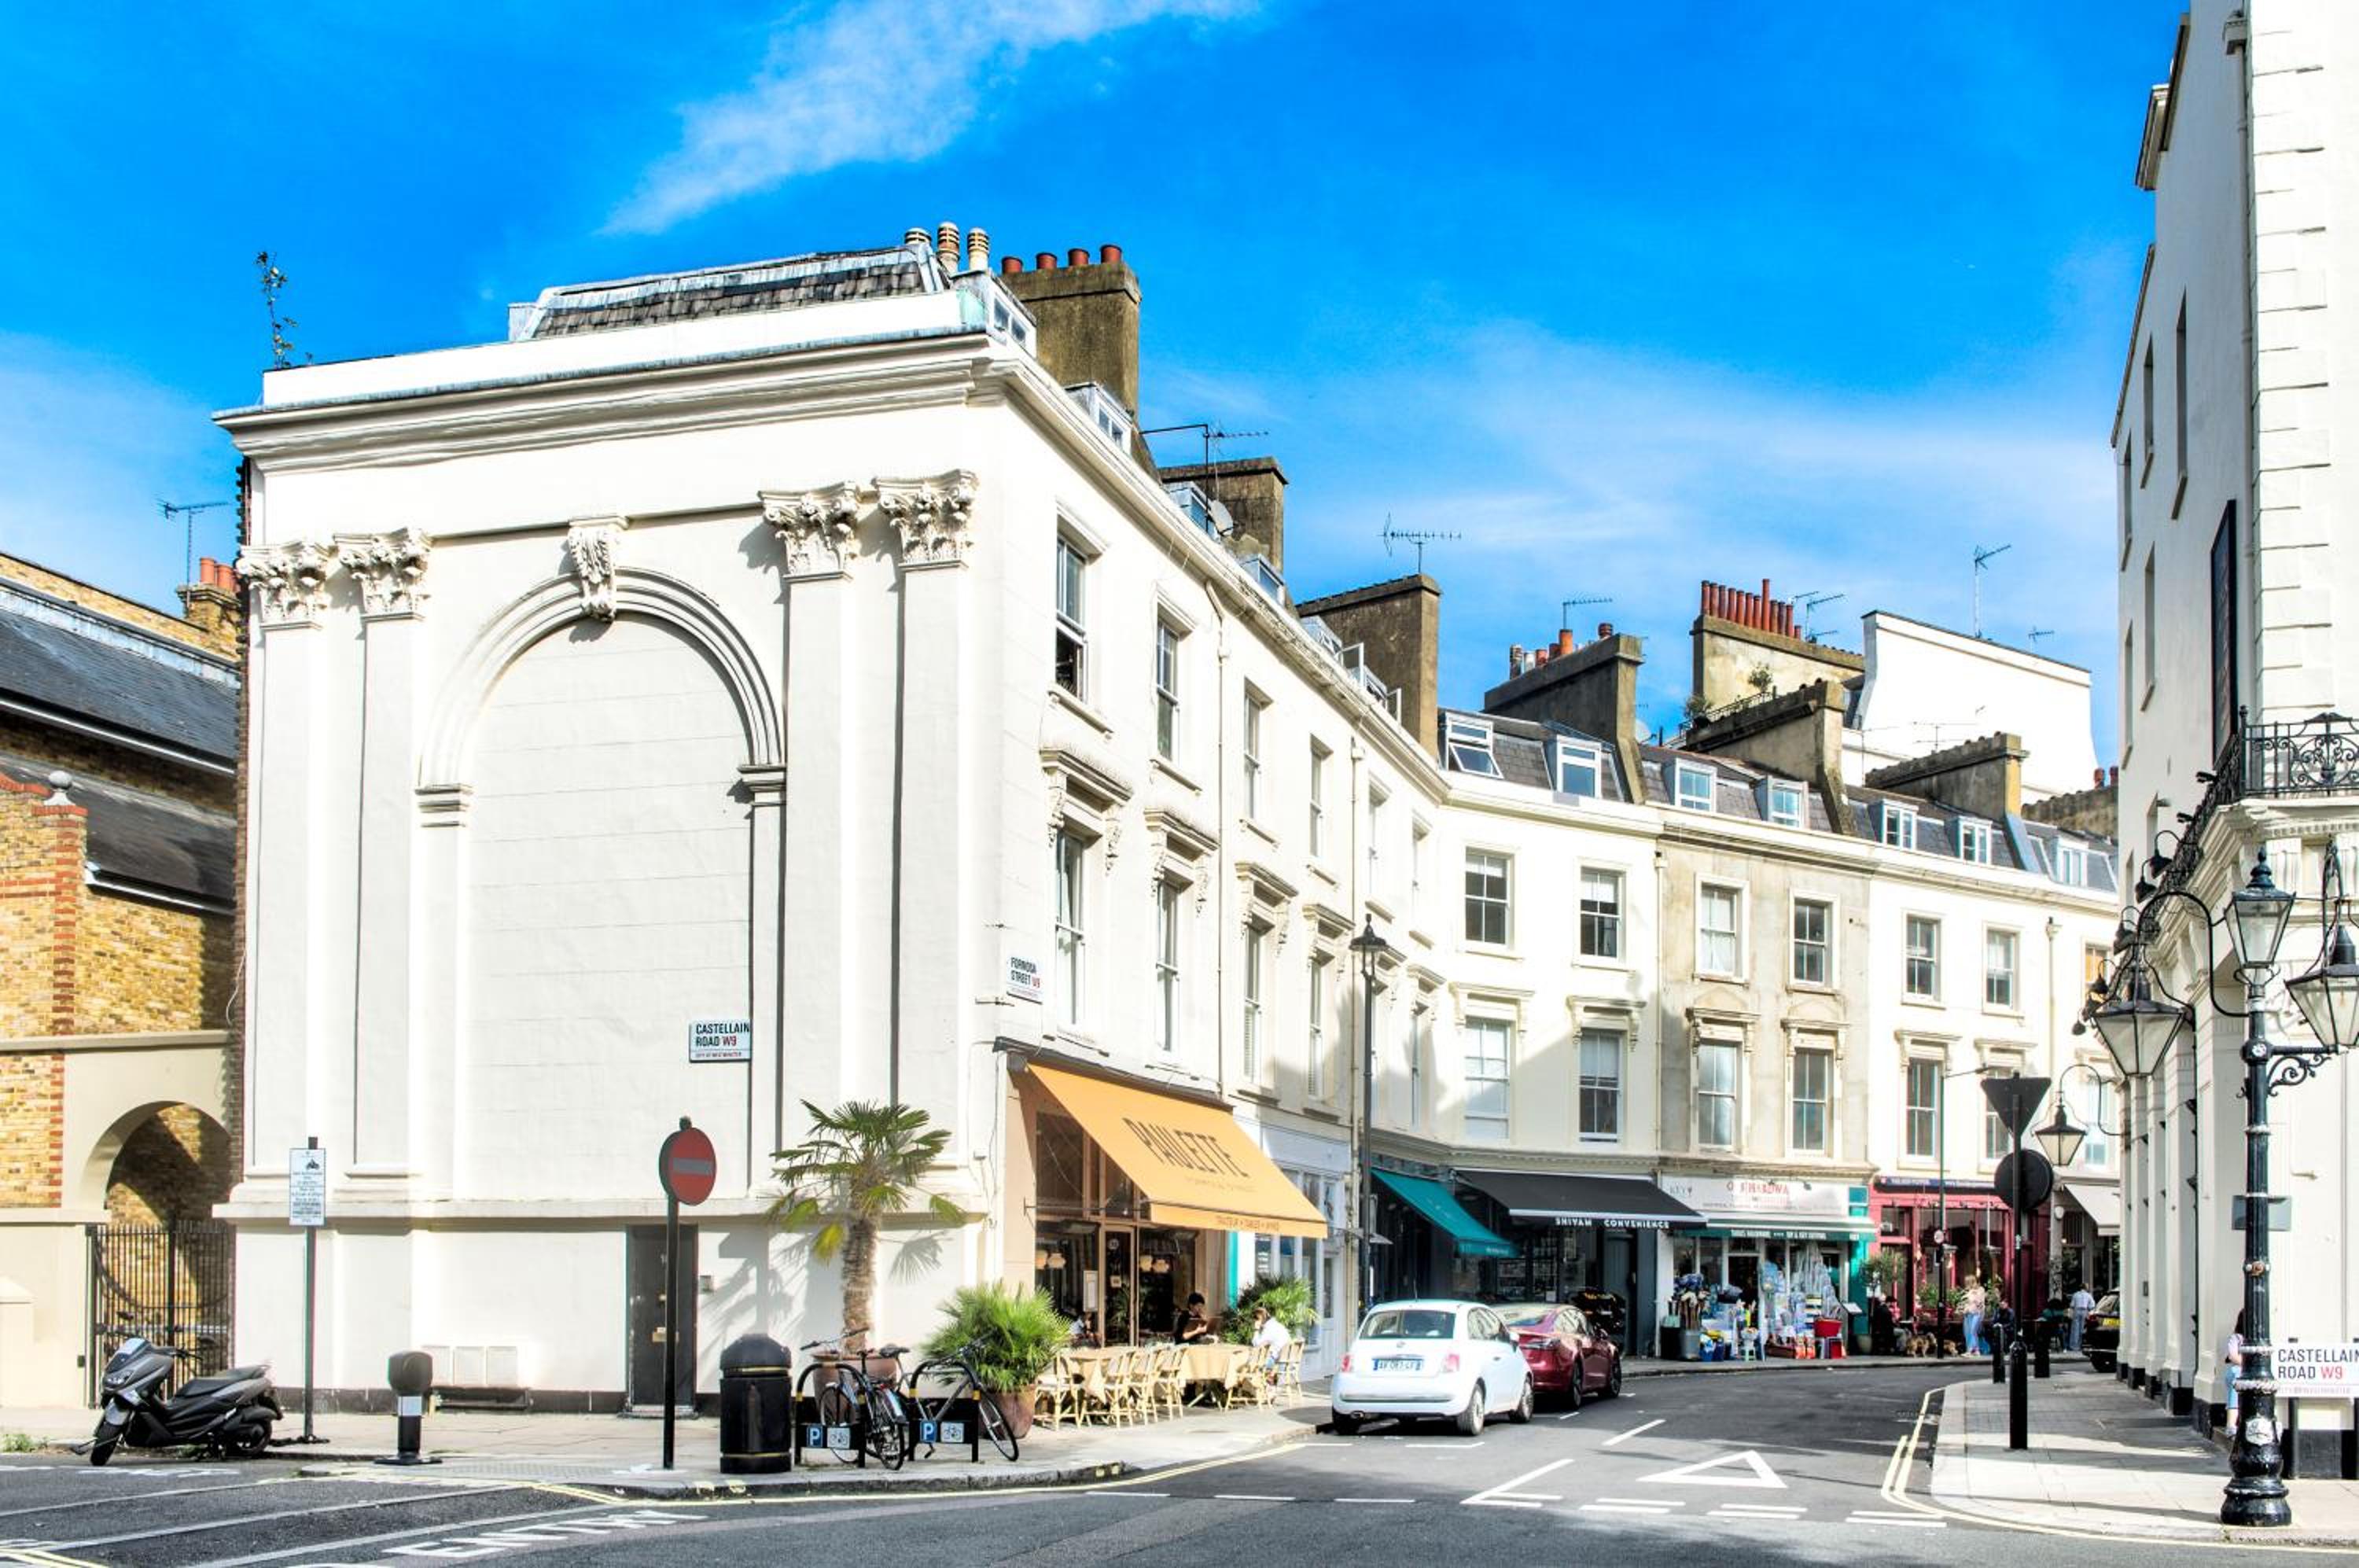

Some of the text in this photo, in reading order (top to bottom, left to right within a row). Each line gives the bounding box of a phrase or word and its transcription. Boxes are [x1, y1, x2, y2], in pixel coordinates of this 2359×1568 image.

[1011, 970, 1040, 988] STREET W9
[696, 1023, 749, 1034] CASTELLAIN
[696, 1036, 737, 1047] ROAD W9
[1122, 1117, 1249, 1177] PAULETTE
[1603, 1219, 1669, 1229] CONVENIENCE
[2278, 1366, 2342, 1379] ROAD W9
[809, 1427, 820, 1446] P
[923, 1423, 933, 1440] P
